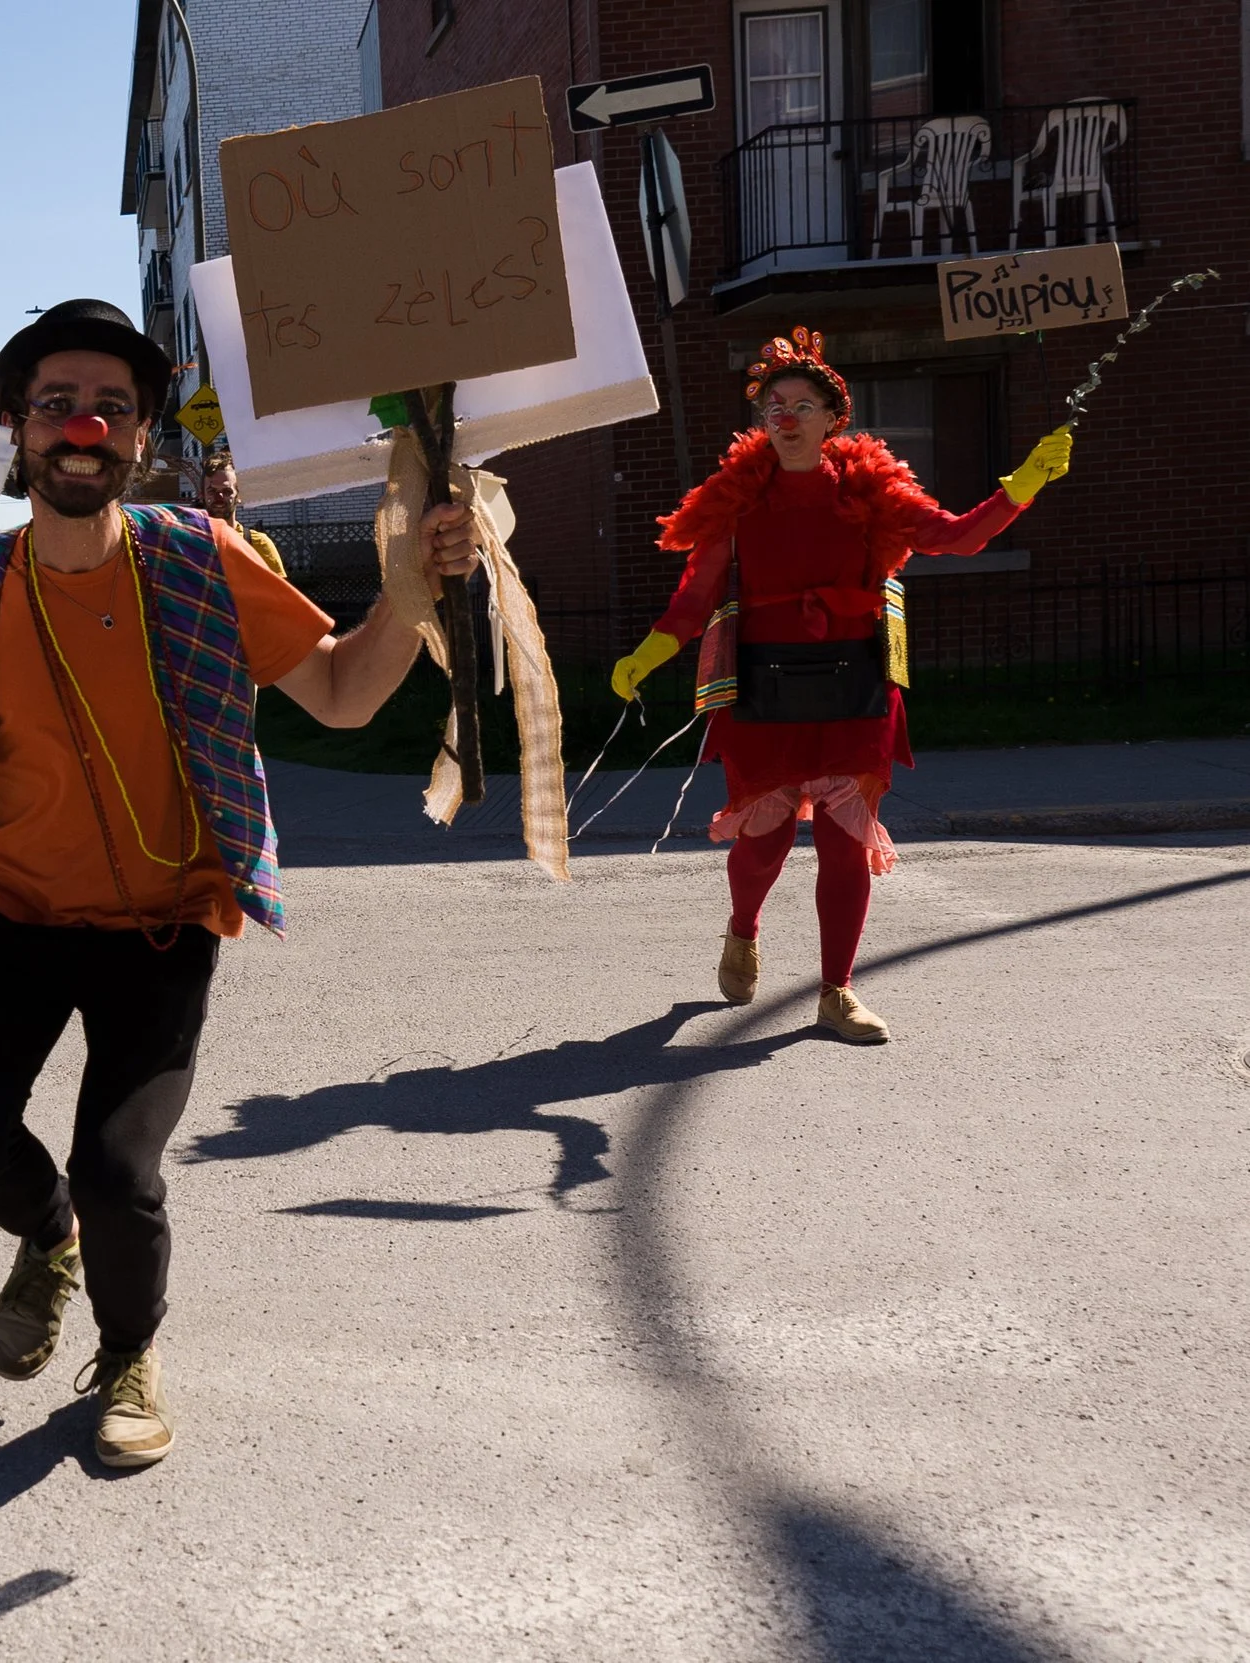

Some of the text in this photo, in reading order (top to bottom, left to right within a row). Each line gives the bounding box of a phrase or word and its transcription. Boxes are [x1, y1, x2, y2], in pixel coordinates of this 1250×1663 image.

[397, 111, 542, 195] sont
[245, 290, 321, 357] tes
[946, 271, 1100, 324] Pioupiou
